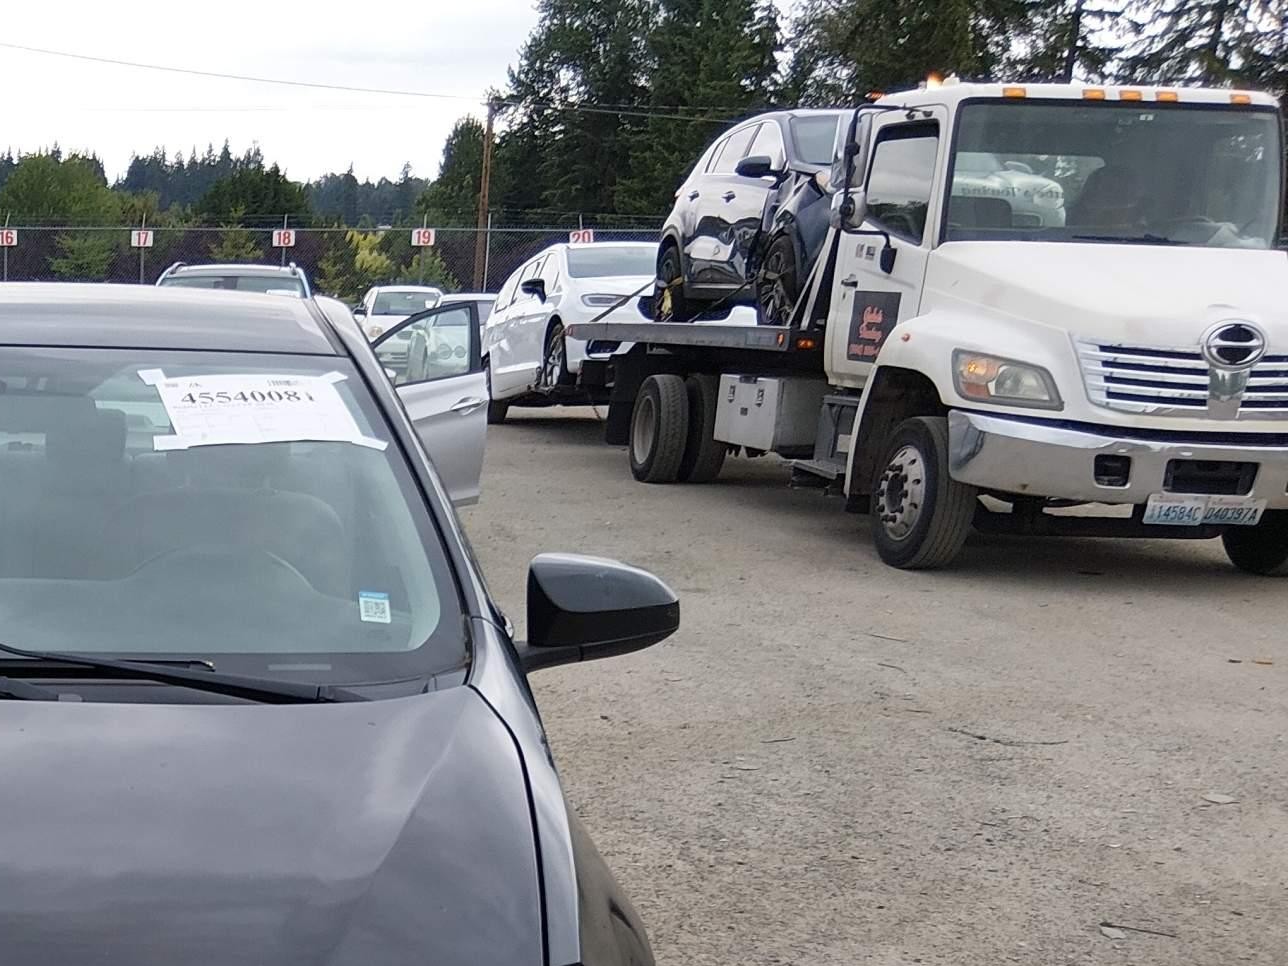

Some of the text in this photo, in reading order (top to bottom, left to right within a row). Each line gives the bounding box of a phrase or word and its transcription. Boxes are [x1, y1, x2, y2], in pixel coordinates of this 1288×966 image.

[0, 231, 14, 245] 16
[135, 231, 150, 246] 17
[277, 231, 292, 245] 18
[416, 231, 431, 245] 19
[572, 231, 591, 243] 20
[181, 390, 315, 404] 45540081
